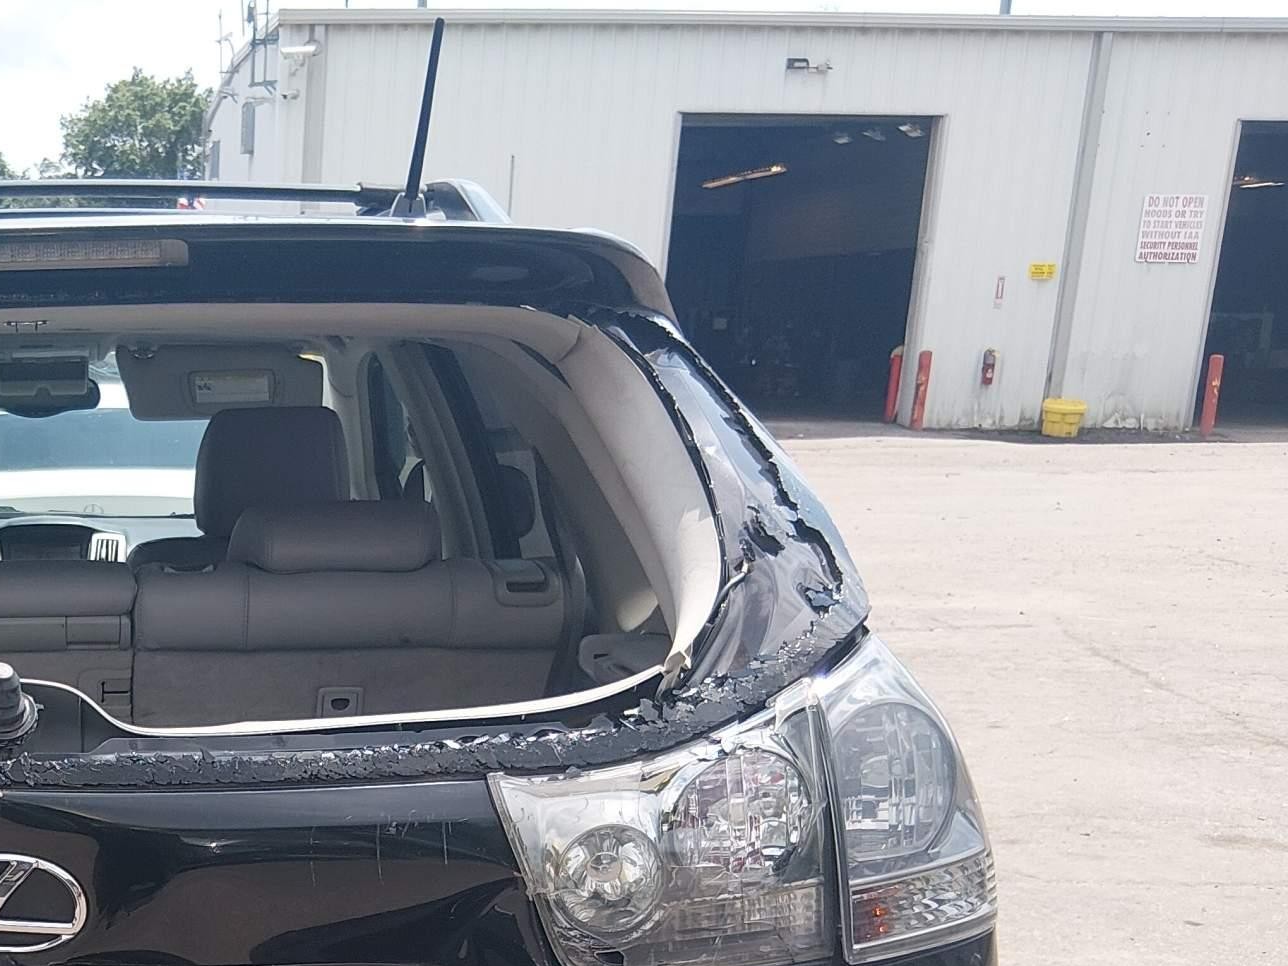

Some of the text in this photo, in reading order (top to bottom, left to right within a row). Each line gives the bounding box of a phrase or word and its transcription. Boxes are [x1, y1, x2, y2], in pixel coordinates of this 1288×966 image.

[1148, 196, 1205, 208] DO NOT OPEN
[1175, 210, 1186, 218] OR
[1189, 210, 1204, 218] TRY
[1142, 220, 1152, 229] TO
[1153, 220, 1173, 229] START
[1141, 230, 1182, 240] WITHOUT
[1140, 241, 1199, 251] SECURITY PERSONNEL
[1138, 251, 1197, 261] AUTHORIZATION
